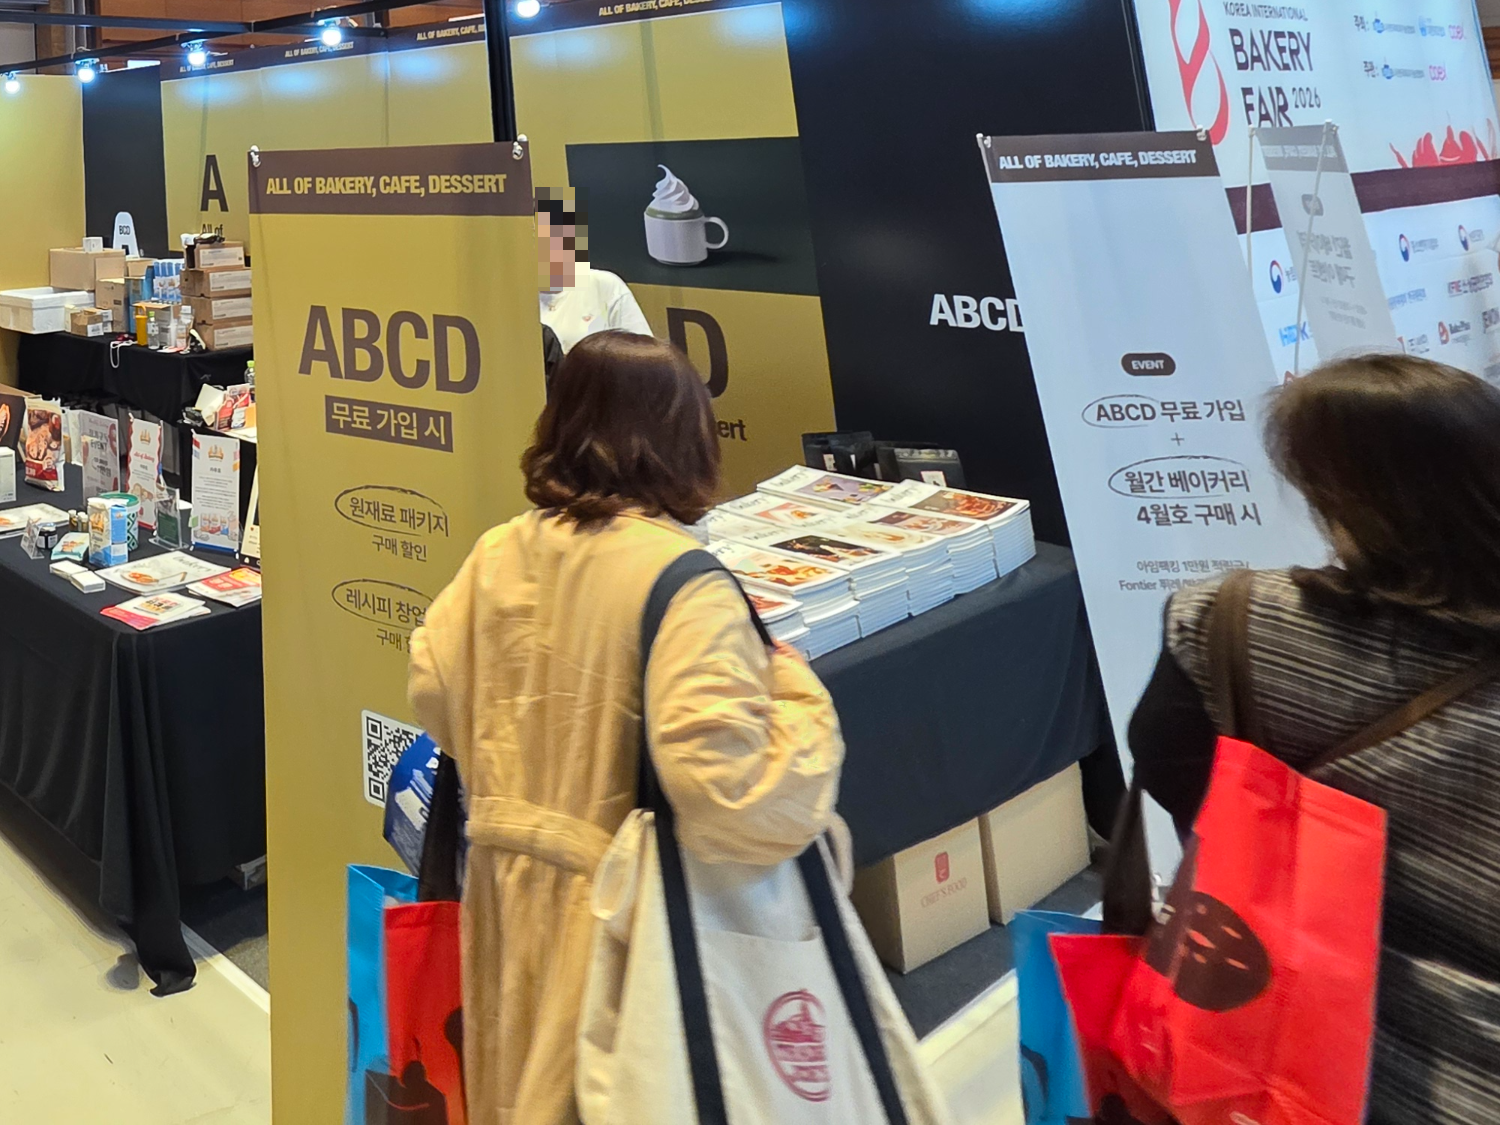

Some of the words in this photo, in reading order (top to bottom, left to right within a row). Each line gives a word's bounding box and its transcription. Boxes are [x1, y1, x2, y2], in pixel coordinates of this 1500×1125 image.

[599, 4, 613, 17] ALL
[614, 4, 625, 15] OF
[1223, 1, 1252, 17] KOREA
[1251, 3, 1308, 22] INTERNATIONAL
[1228, 28, 1313, 72] BAKERY
[1241, 86, 1293, 128] FAIR
[1292, 87, 1322, 109] 2026
[999, 156, 1023, 170] ALL
[1025, 155, 1042, 168] OF
[1044, 153, 1099, 169] BAKERY,
[1099, 151, 1138, 168] CAFE,
[1138, 150, 1196, 165] DESSERT
[266, 178, 291, 195] ALL
[294, 177, 312, 194] OF
[315, 176, 376, 197] BAKERY,
[379, 175, 425, 197] CAFE,
[428, 174, 507, 194] DESSERT
[119, 225, 131, 235] BCD
[298, 305, 481, 394] ABCD
[1131, 360, 1165, 370] EVENT
[1096, 403, 1156, 422] ABCD
[1160, 401, 1202, 423] 무료
[1203, 399, 1246, 422] 가입
[331, 402, 372, 430] 무료
[376, 408, 418, 440] 가입
[424, 416, 446, 445] 시
[1124, 470, 1165, 494] 월간
[1167, 469, 1251, 493] 베이커리
[349, 496, 396, 524] 원재료
[399, 508, 449, 537] 패키지
[1136, 503, 1193, 526] 4월호
[1194, 502, 1238, 526] 구매
[1241, 502, 1262, 526] 시
[371, 535, 398, 557] 구매
[401, 540, 428, 562] 할인
[1118, 580, 1158, 591] Fontier
[346, 588, 392, 619] 레시피
[396, 600, 427, 627] 창업
[376, 628, 402, 652] 구매
